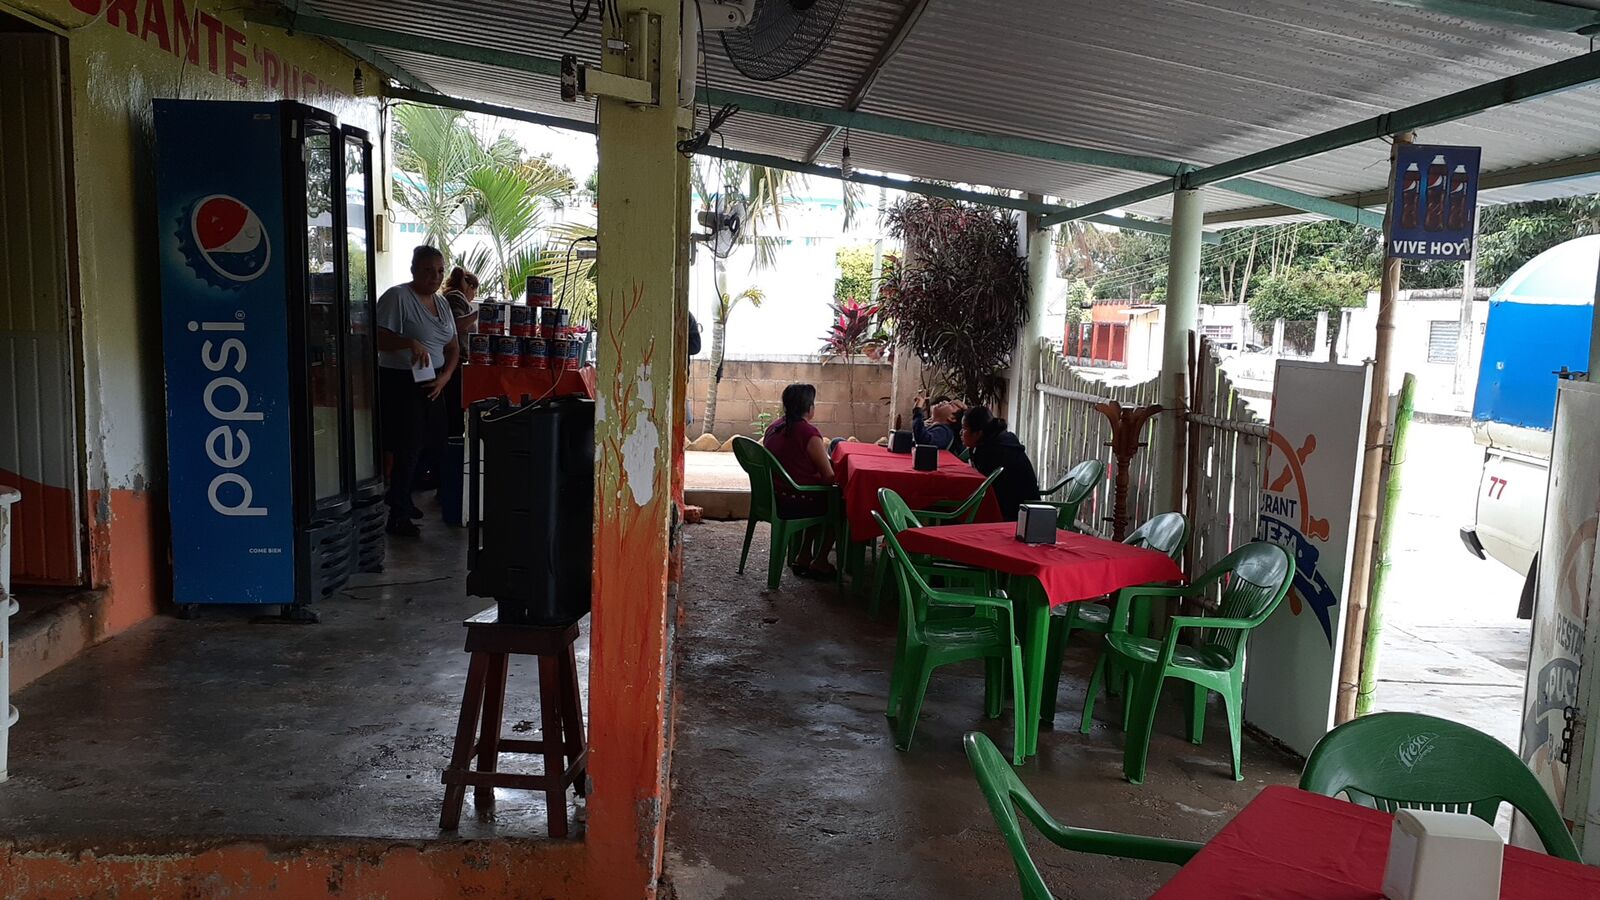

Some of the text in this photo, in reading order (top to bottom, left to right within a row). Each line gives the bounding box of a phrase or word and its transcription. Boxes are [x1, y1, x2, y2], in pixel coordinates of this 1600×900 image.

[70, 0, 247, 88] RANTE
[1393, 240, 1464, 256] VIVE HOY
[187, 321, 268, 516] pepsi
[1488, 475, 1508, 500] 77
